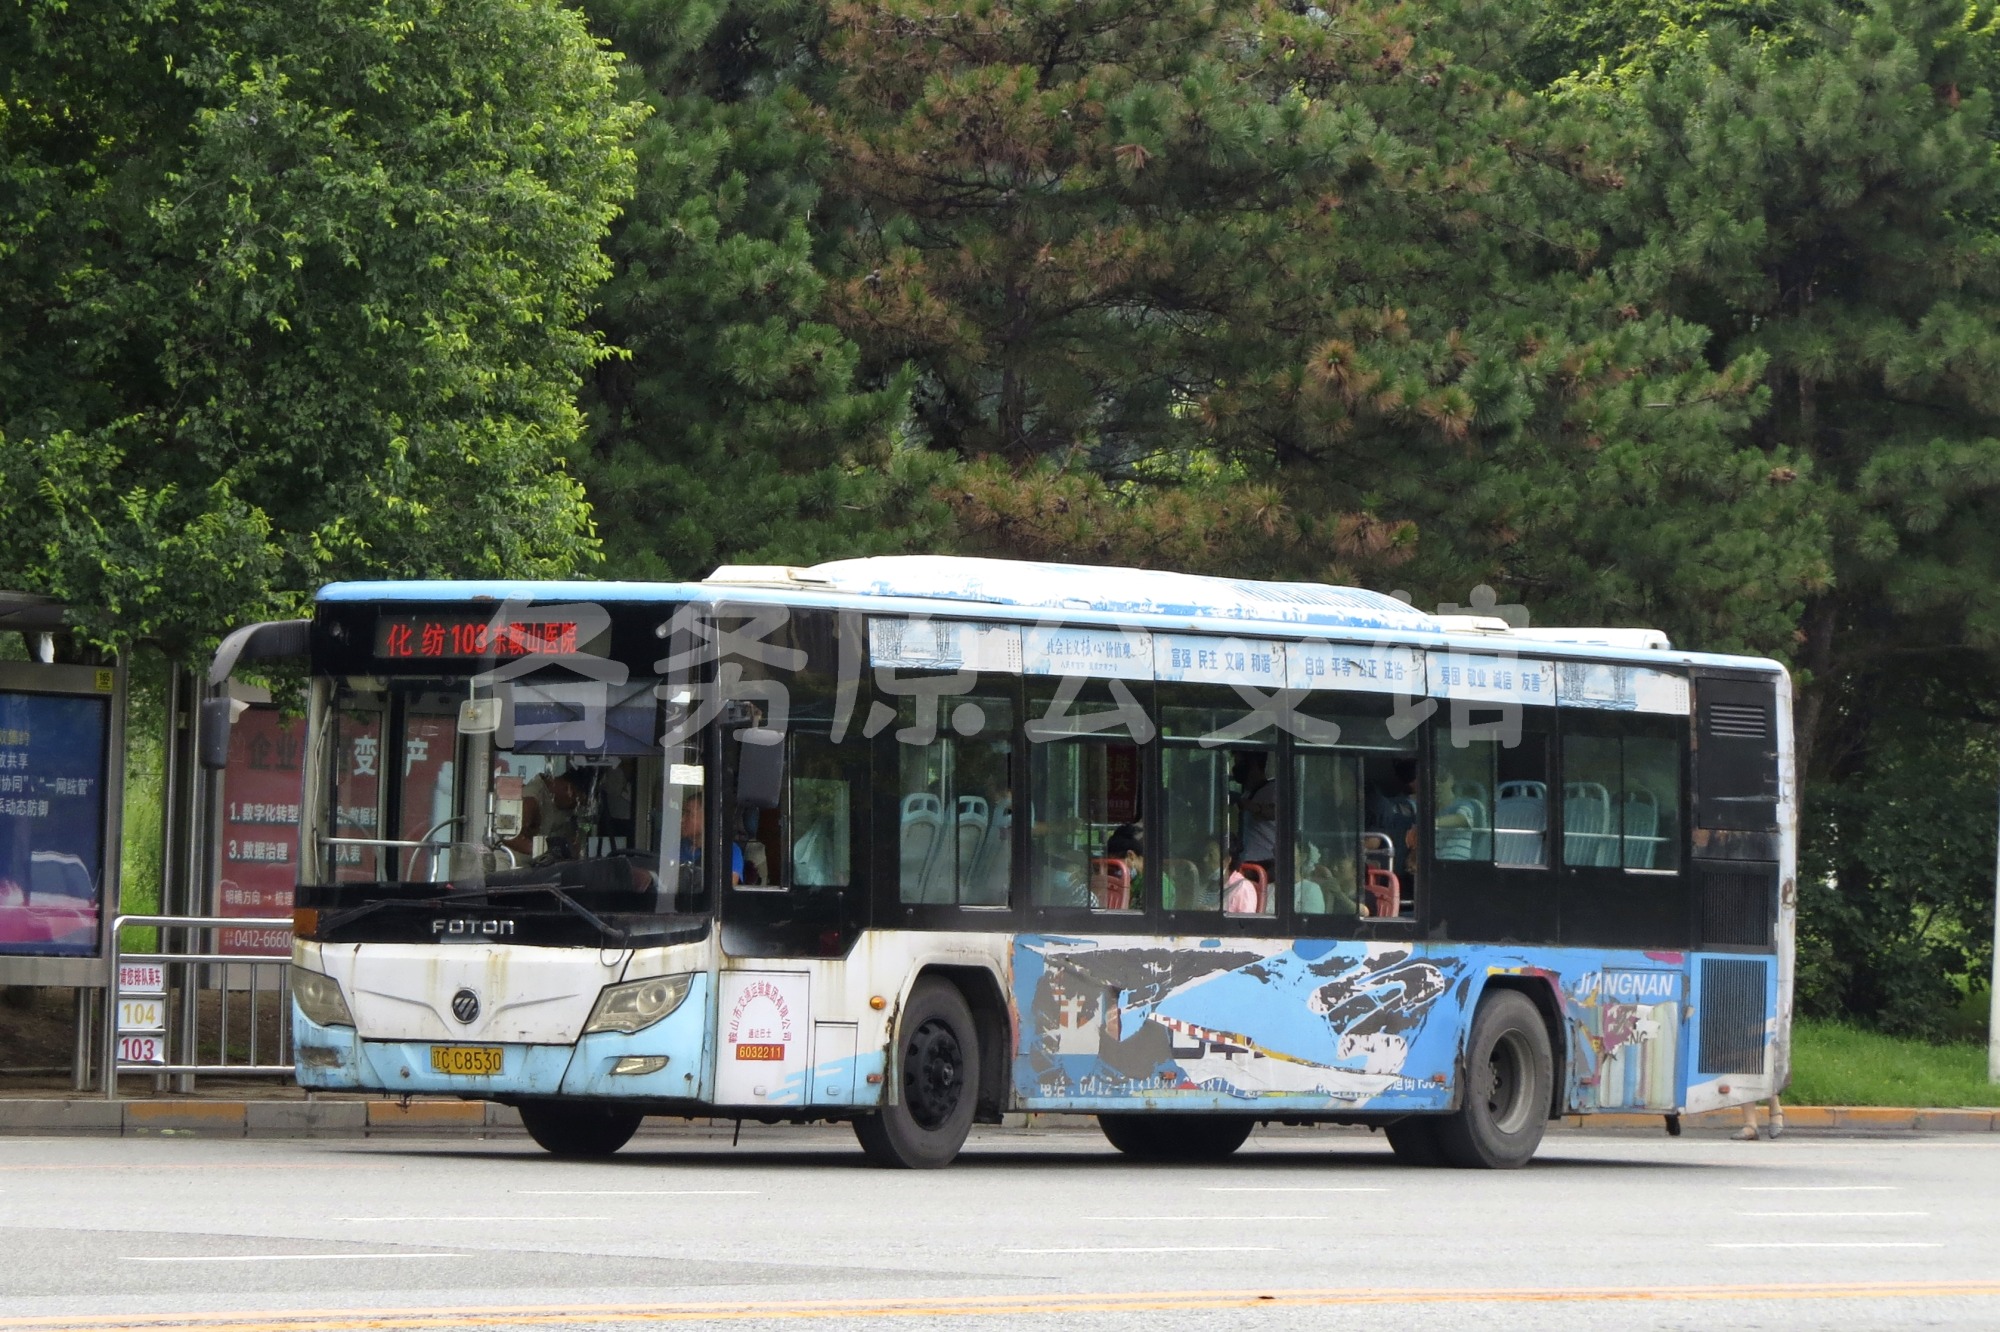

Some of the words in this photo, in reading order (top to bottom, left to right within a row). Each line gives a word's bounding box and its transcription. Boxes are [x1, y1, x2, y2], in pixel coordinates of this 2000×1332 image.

[451, 622, 488, 654] 103
[1171, 647, 1192, 669] 富强
[1198, 649, 1218, 670] 民主
[1305, 655, 1325, 676] 自由
[433, 920, 514, 935] FOTON
[123, 1003, 156, 1024] 104
[122, 1038, 155, 1060] 103
[739, 1046, 781, 1058] 6032211
